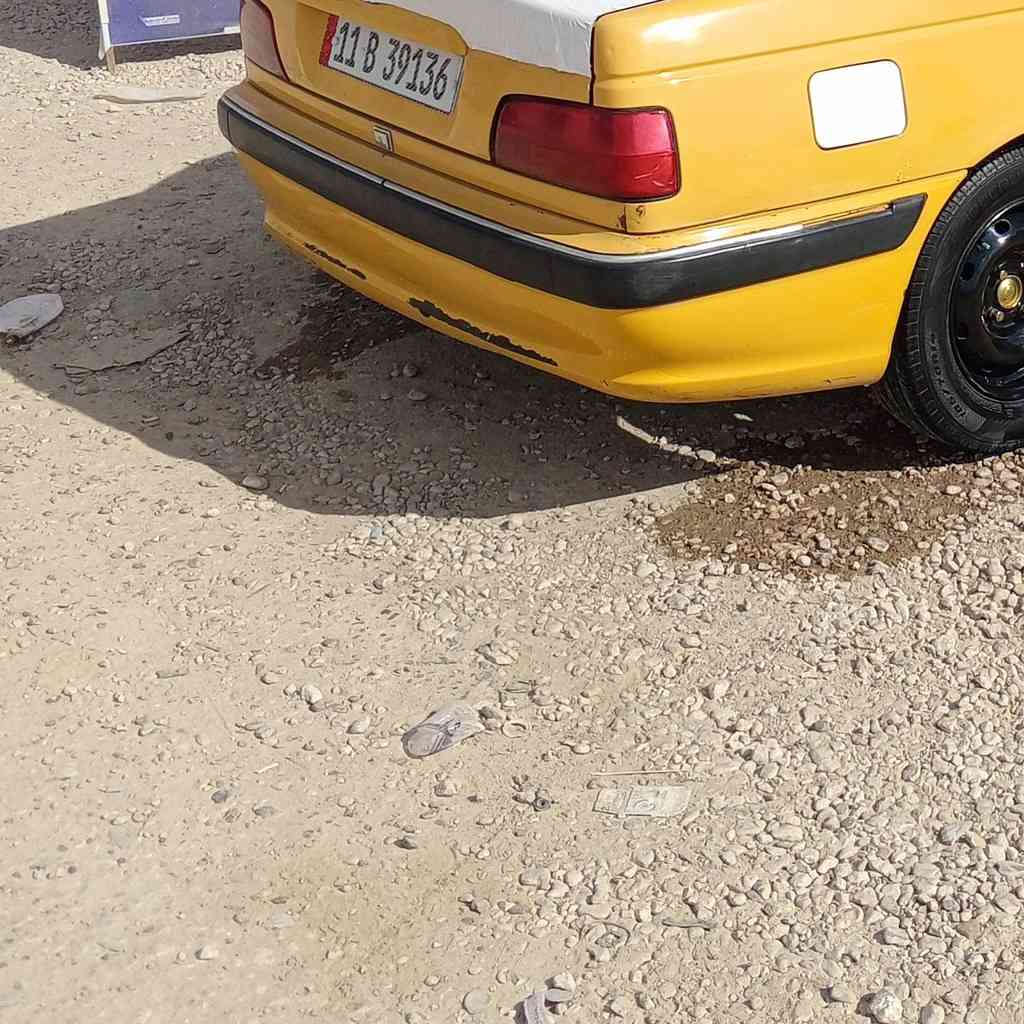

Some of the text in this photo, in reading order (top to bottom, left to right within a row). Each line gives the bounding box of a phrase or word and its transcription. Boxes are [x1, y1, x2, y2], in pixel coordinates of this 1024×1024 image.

[333, 22, 451, 100] 11 B 39136
